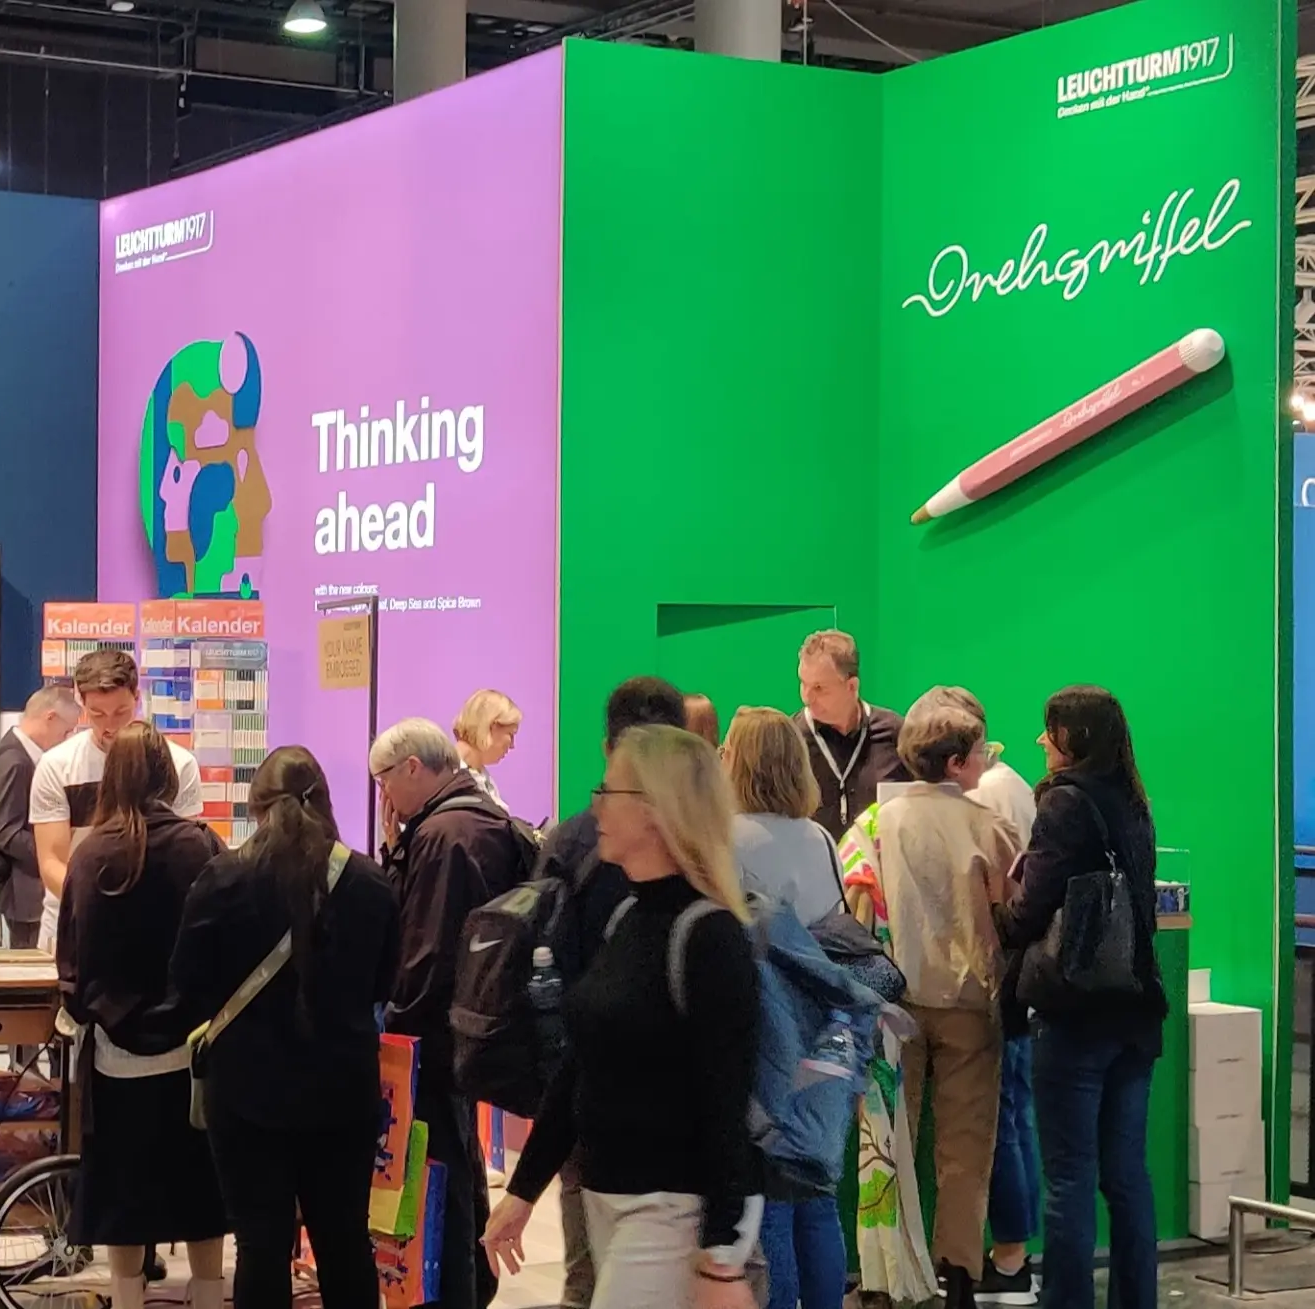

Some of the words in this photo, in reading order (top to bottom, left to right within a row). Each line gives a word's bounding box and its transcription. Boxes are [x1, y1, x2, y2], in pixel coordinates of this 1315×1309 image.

[1057, 36, 1220, 103] LEUCHTTURM1917
[115, 211, 206, 260] LEUCHTTURM1917
[902, 178, 1252, 317] Drehgriffel
[311, 396, 484, 473] Thinking
[314, 482, 436, 554] ahead
[47, 618, 132, 635] Kalender
[176, 616, 261, 635] Kalender
